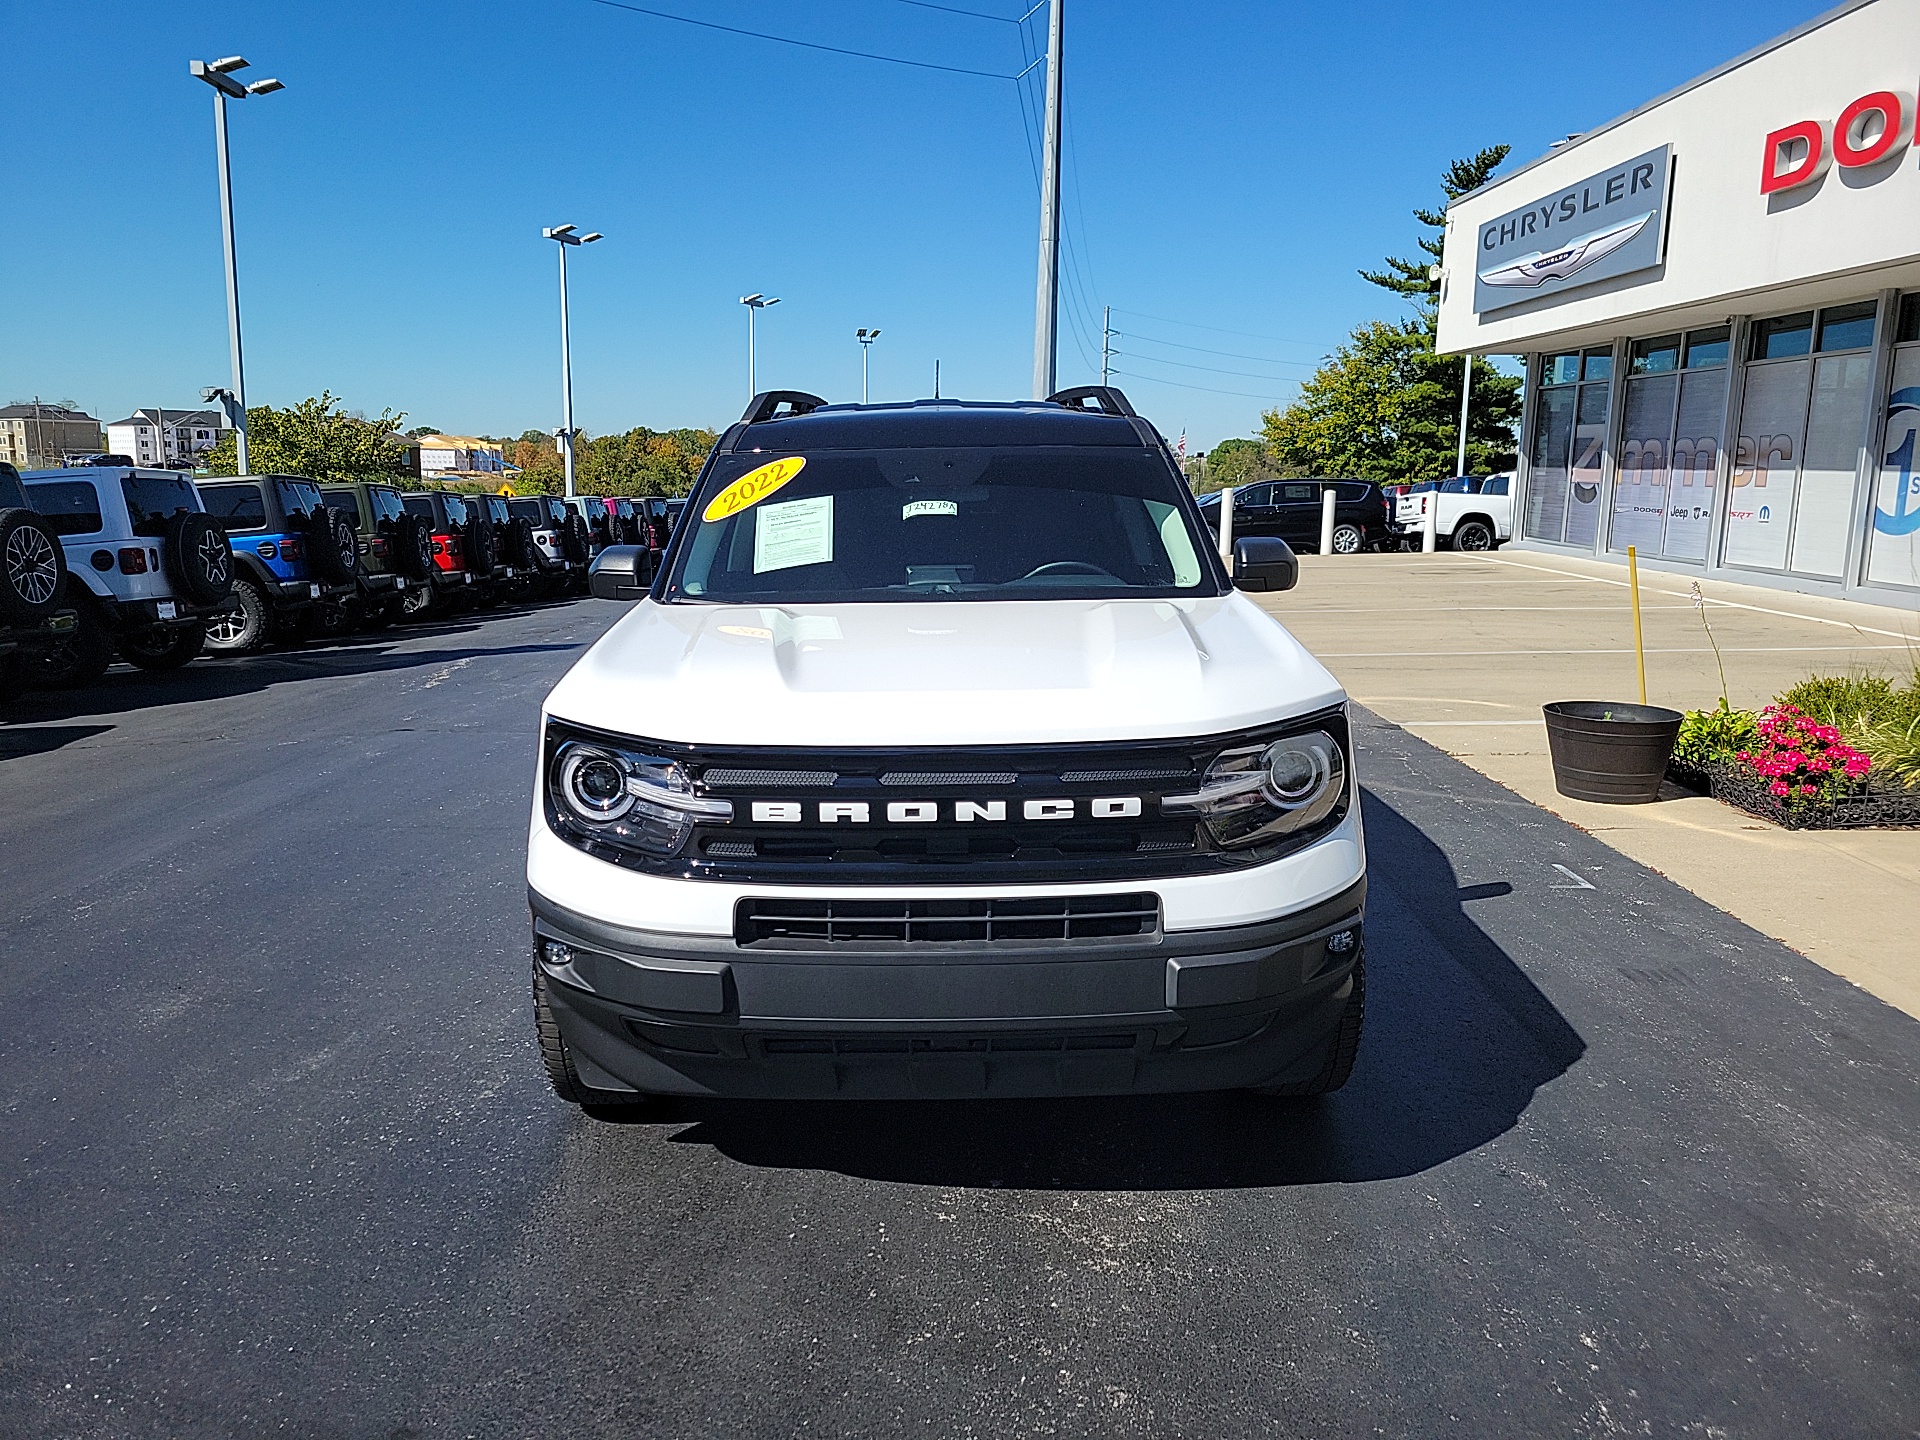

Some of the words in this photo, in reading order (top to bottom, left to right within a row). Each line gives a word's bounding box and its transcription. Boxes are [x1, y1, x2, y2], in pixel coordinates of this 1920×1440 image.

[1760, 74, 1920, 195] DO
[1483, 162, 1655, 250] CHRYSLER
[723, 463, 788, 513] 2022
[1671, 506, 1688, 520] Jeep
[751, 797, 1142, 823] BRONCO
